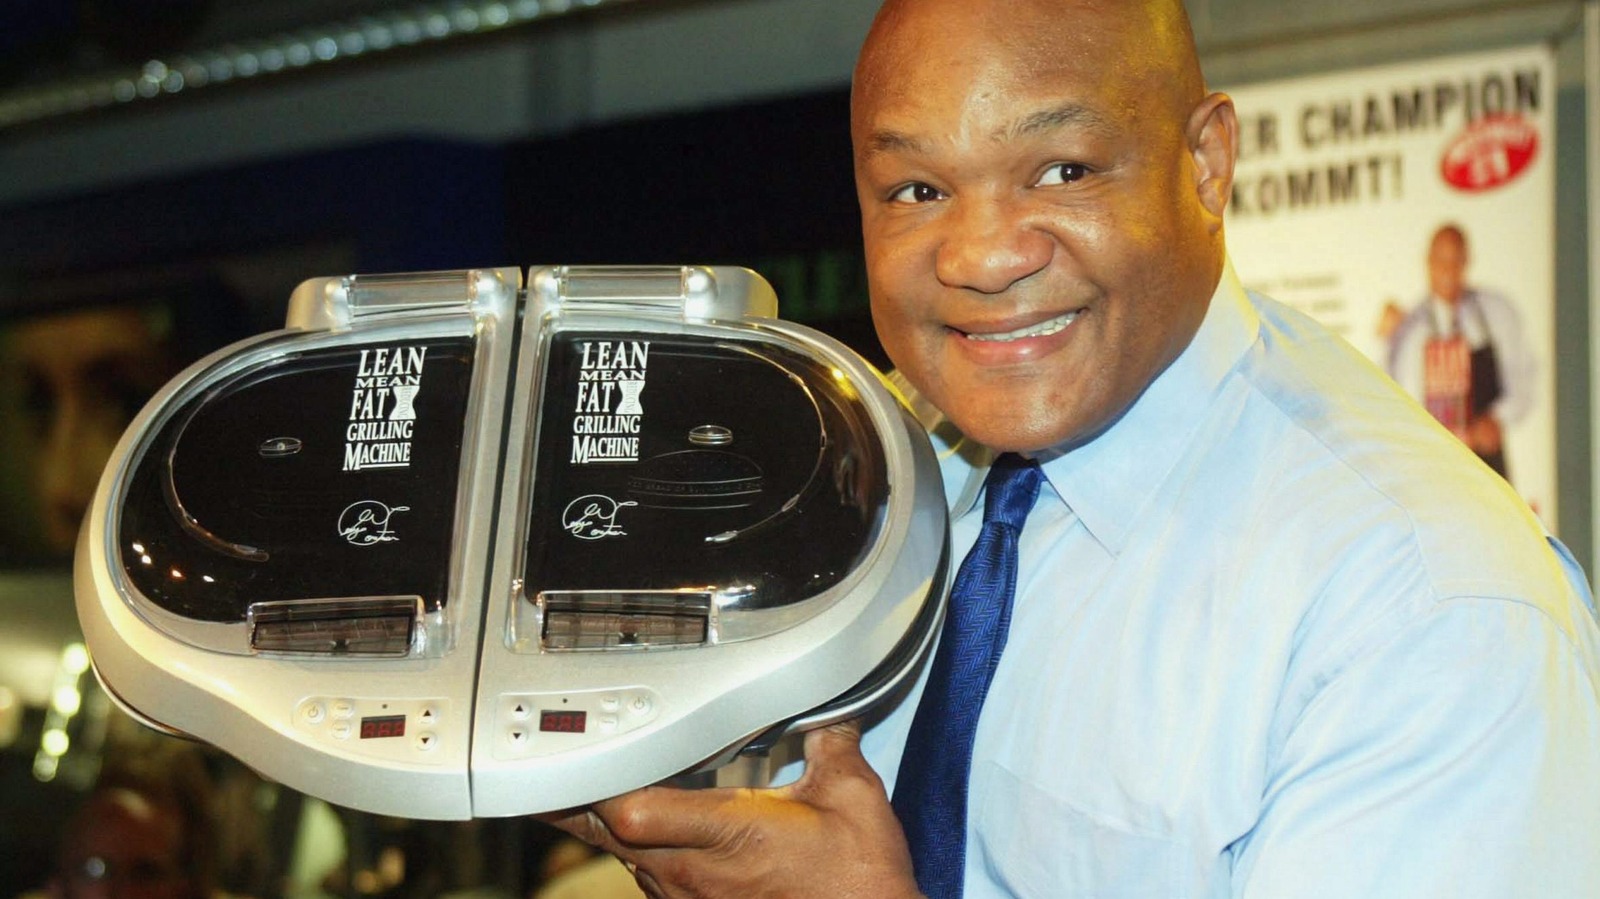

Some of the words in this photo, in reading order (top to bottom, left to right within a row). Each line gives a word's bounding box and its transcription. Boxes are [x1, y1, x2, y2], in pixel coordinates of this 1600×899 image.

[1302, 67, 1541, 148] CHAMPION
[1232, 152, 1404, 216] KOMMT!
[357, 346, 428, 377] LEAN
[580, 341, 650, 369] LEAN
[354, 375, 421, 389] MEAN
[579, 370, 646, 381] MEAN
[350, 388, 390, 420] FAT
[574, 382, 615, 413] FAT
[347, 420, 413, 442] GRILLING
[573, 415, 641, 434] GRILLING
